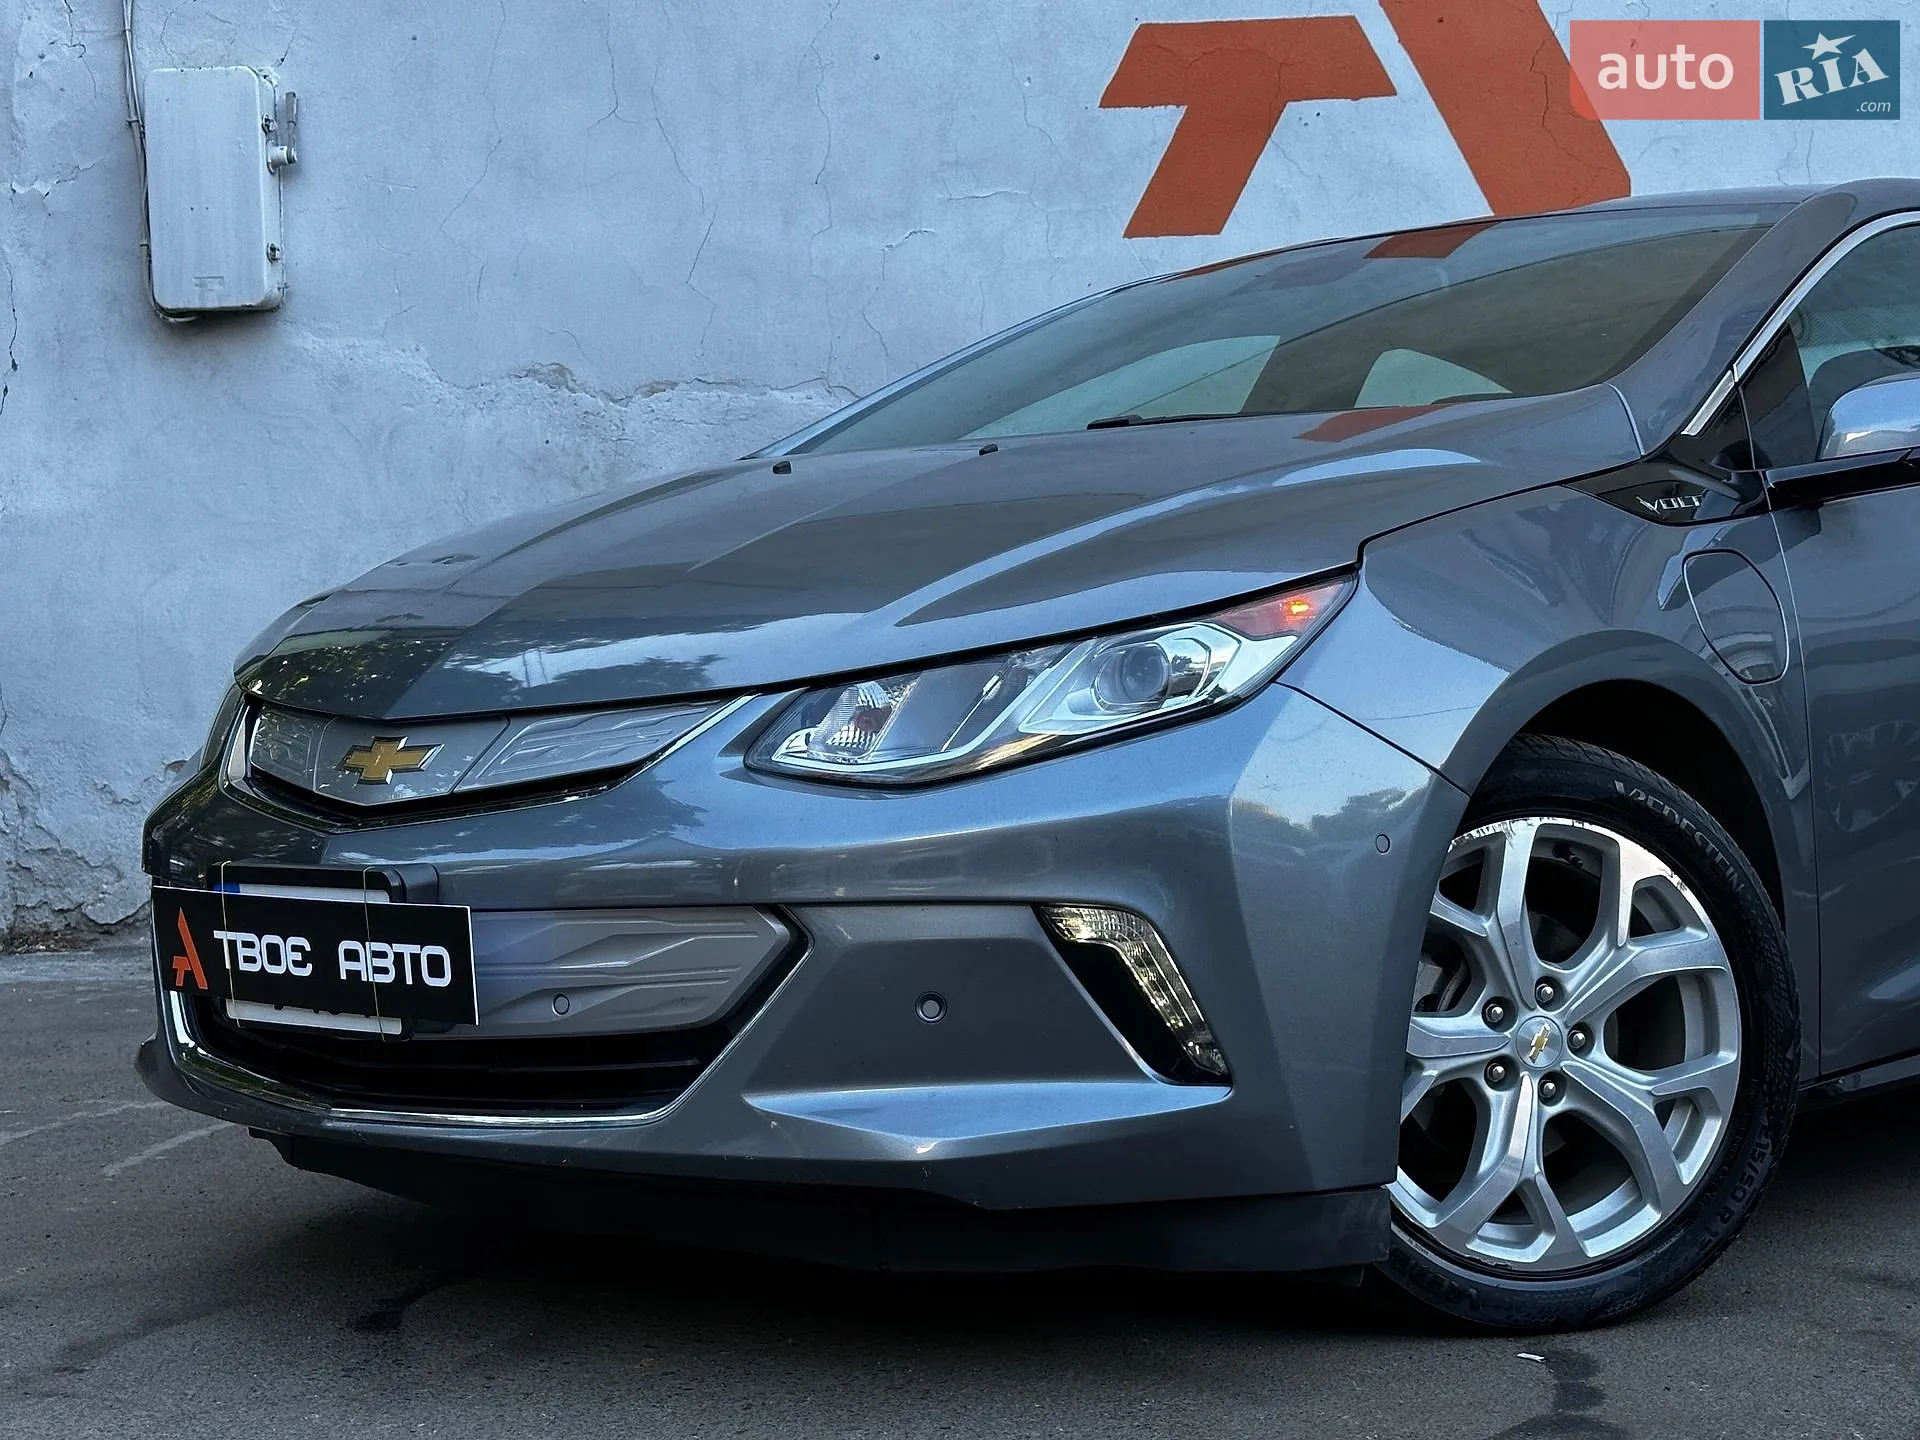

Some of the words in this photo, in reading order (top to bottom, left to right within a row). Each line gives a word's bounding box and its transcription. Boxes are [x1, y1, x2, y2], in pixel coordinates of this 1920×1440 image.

[1636, 494, 1702, 515] VOLT
[213, 930, 313, 977] ТВОЄ
[339, 940, 452, 988] АВТО
